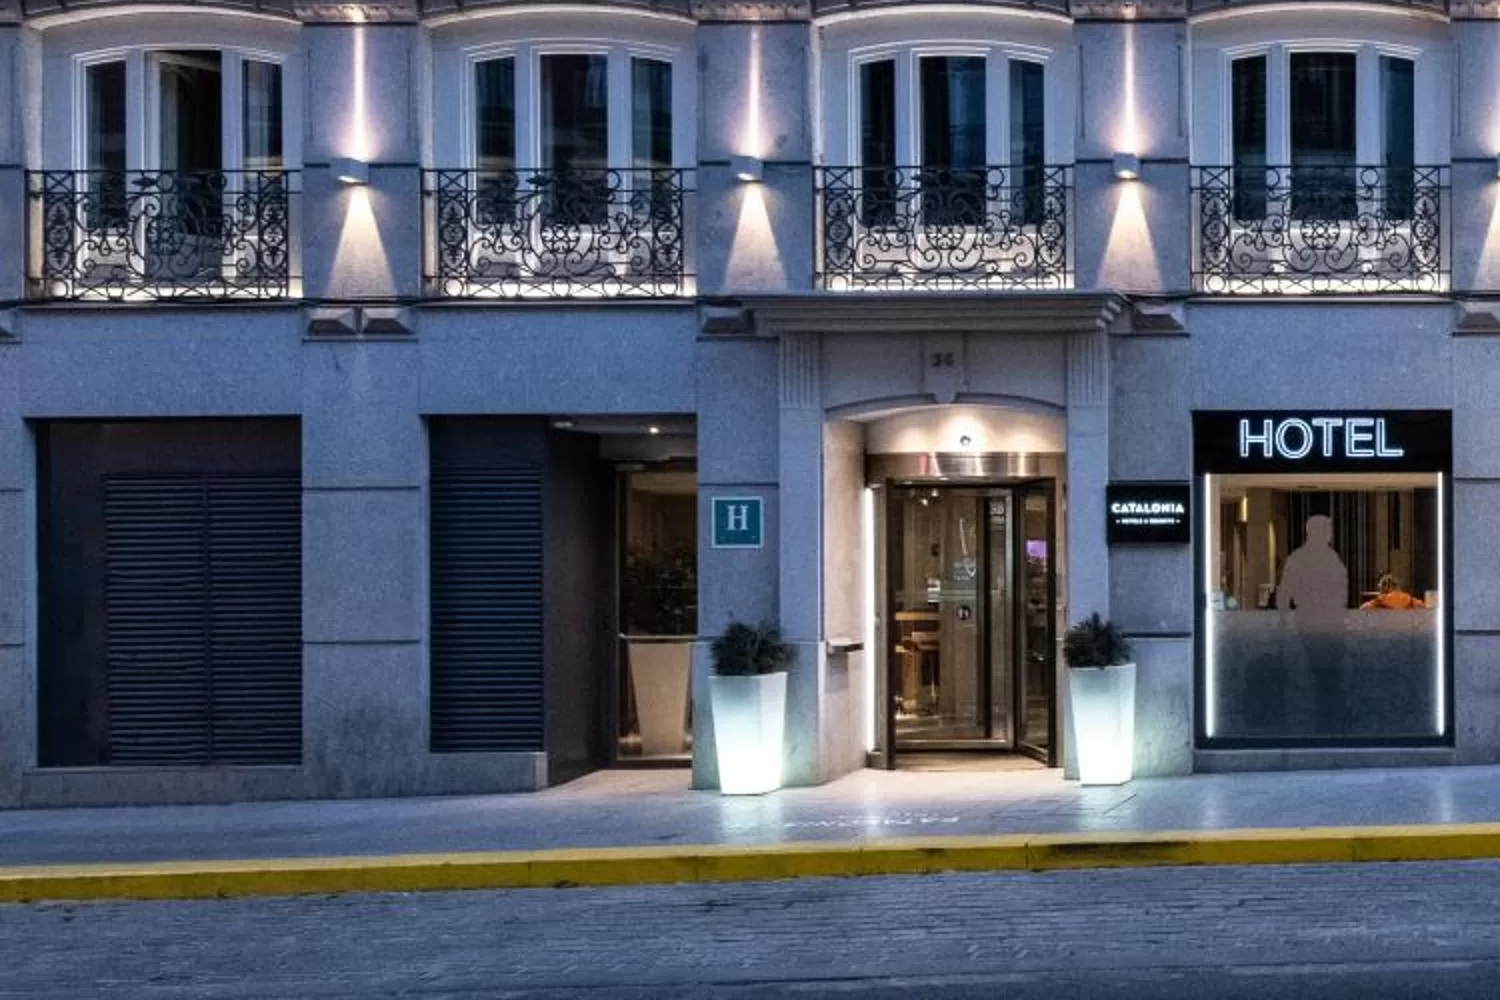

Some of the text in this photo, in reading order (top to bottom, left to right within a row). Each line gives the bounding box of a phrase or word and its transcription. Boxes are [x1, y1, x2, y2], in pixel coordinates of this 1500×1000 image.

[1239, 416, 1405, 459] HOTEL
[727, 504, 749, 530] H
[1111, 502, 1185, 514] CATALONIA
